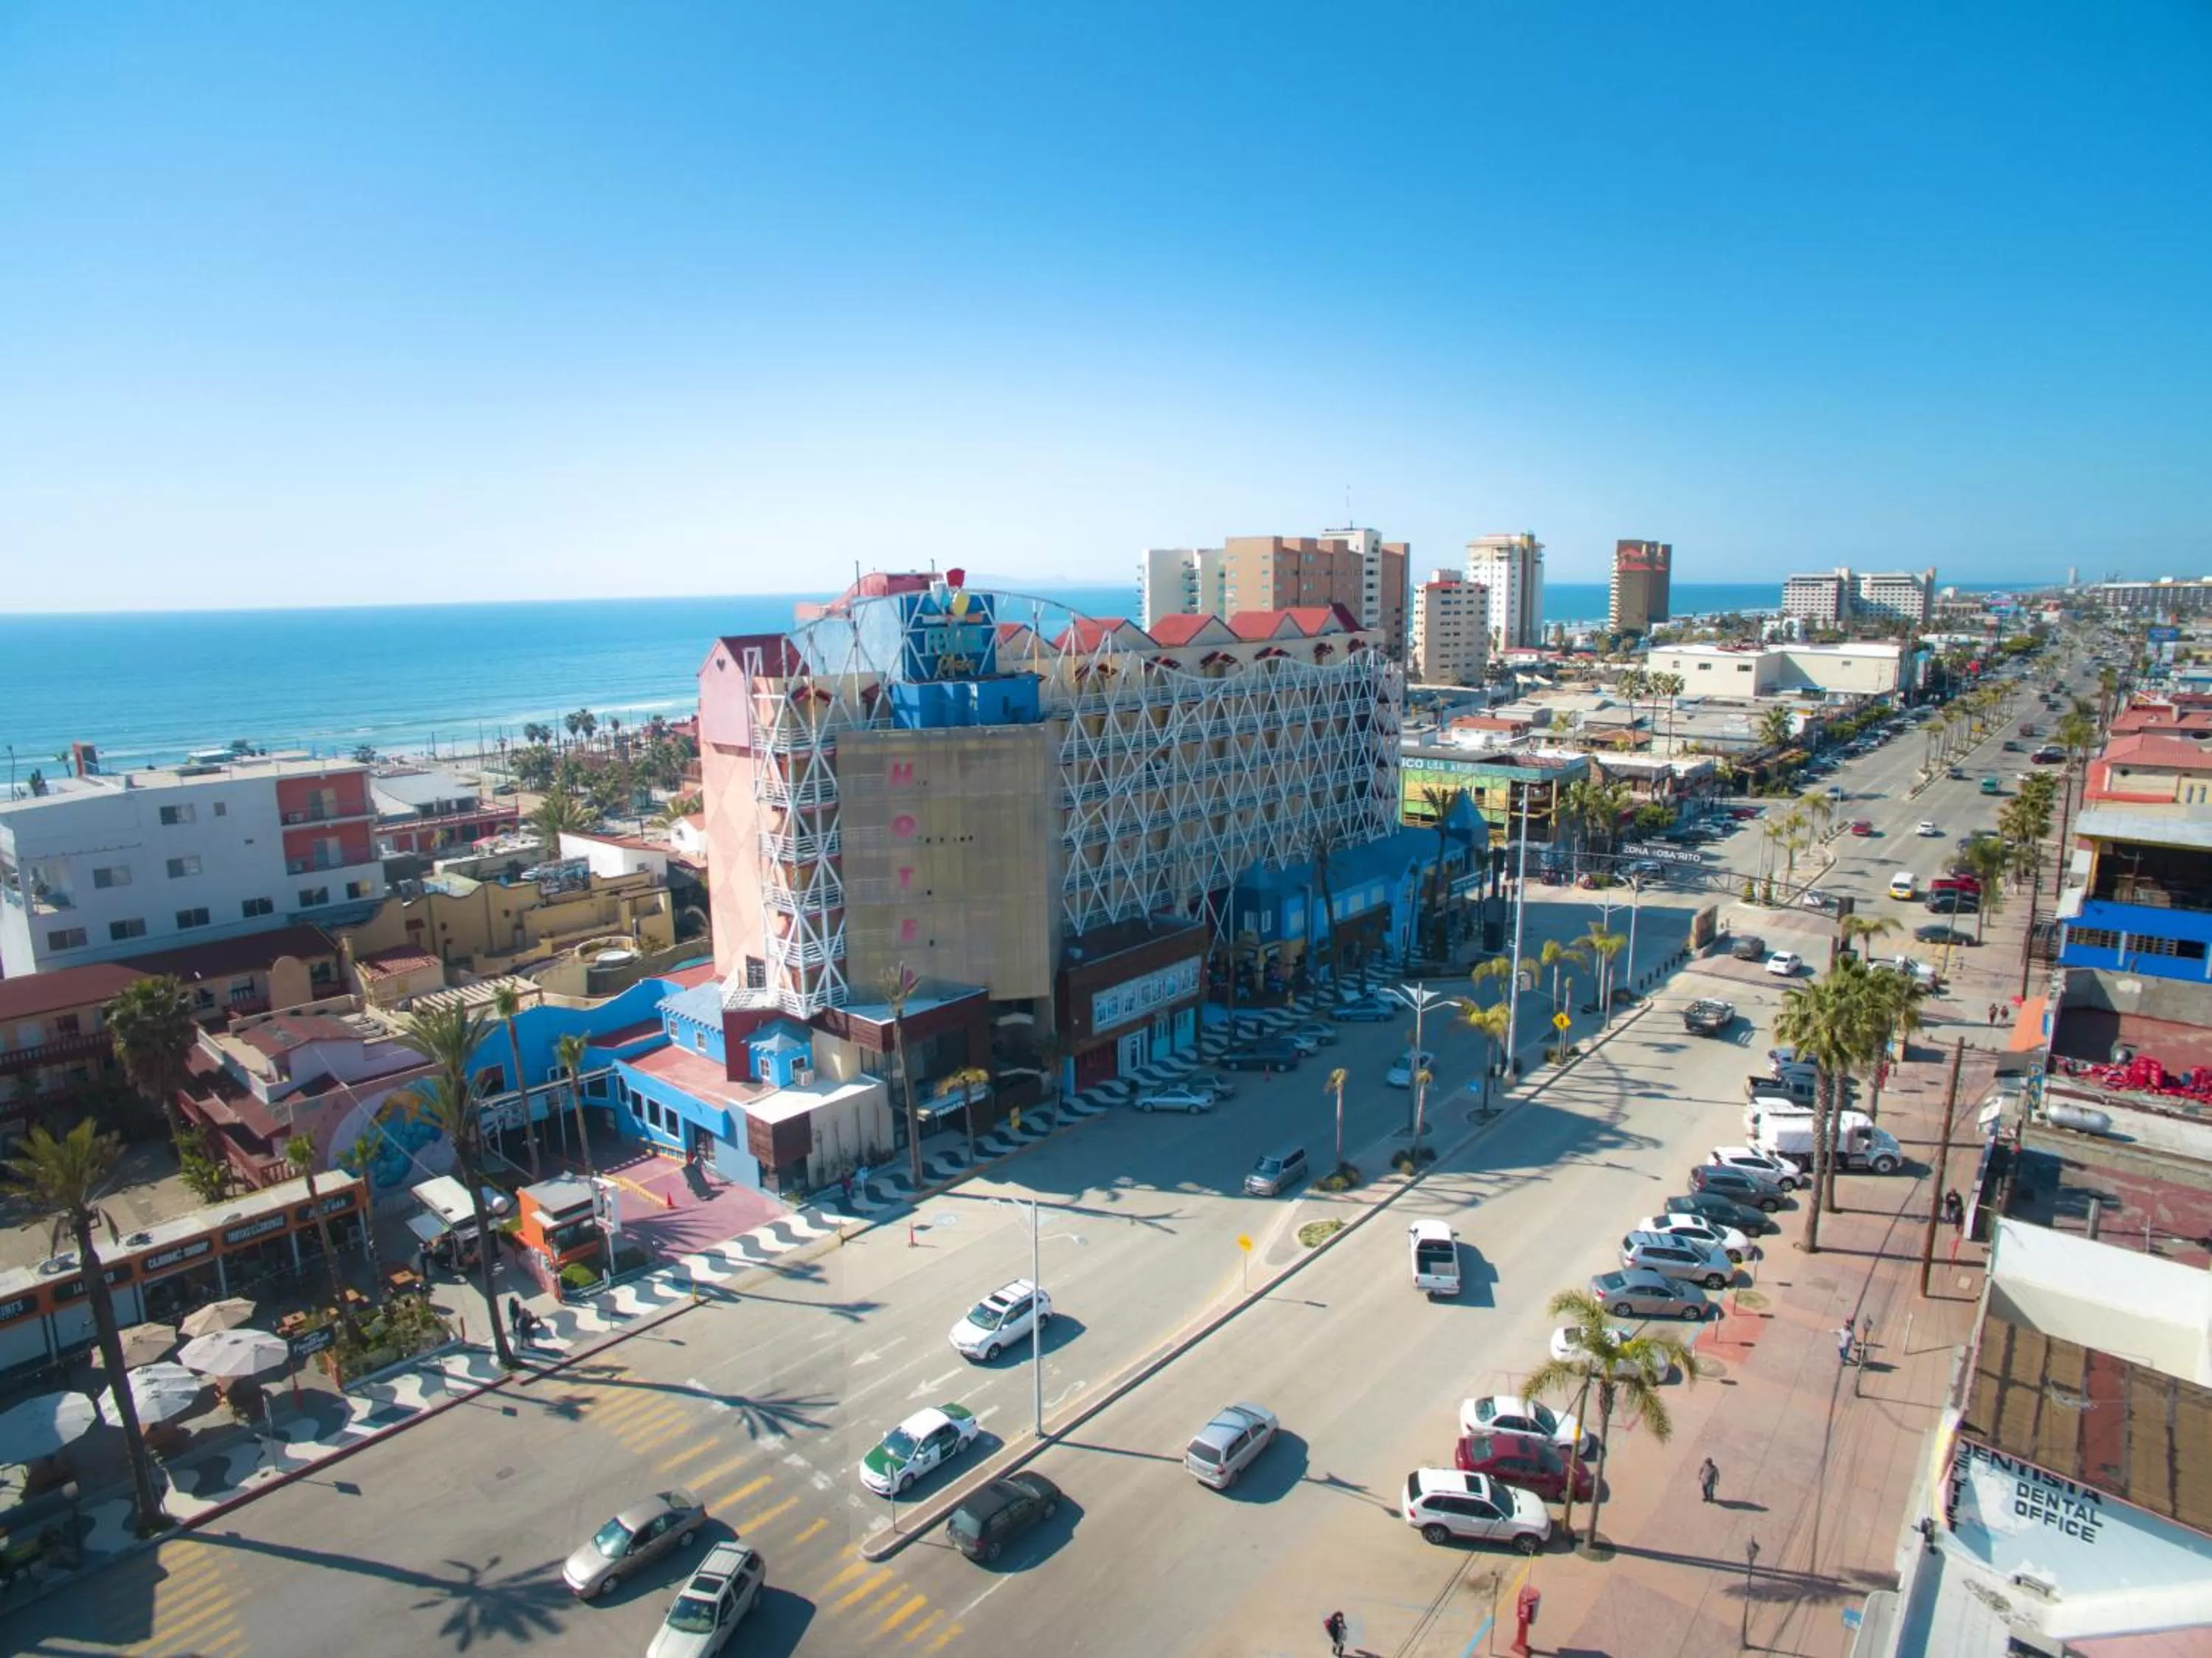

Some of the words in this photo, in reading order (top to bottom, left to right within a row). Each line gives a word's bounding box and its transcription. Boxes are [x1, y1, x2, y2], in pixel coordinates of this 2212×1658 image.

[1624, 844, 1649, 856] ZONA
[1957, 1439, 2103, 1505] DENTISTA
[2015, 1500, 2096, 1544] OFFICE
[2017, 1482, 2103, 1527] DENTAL
